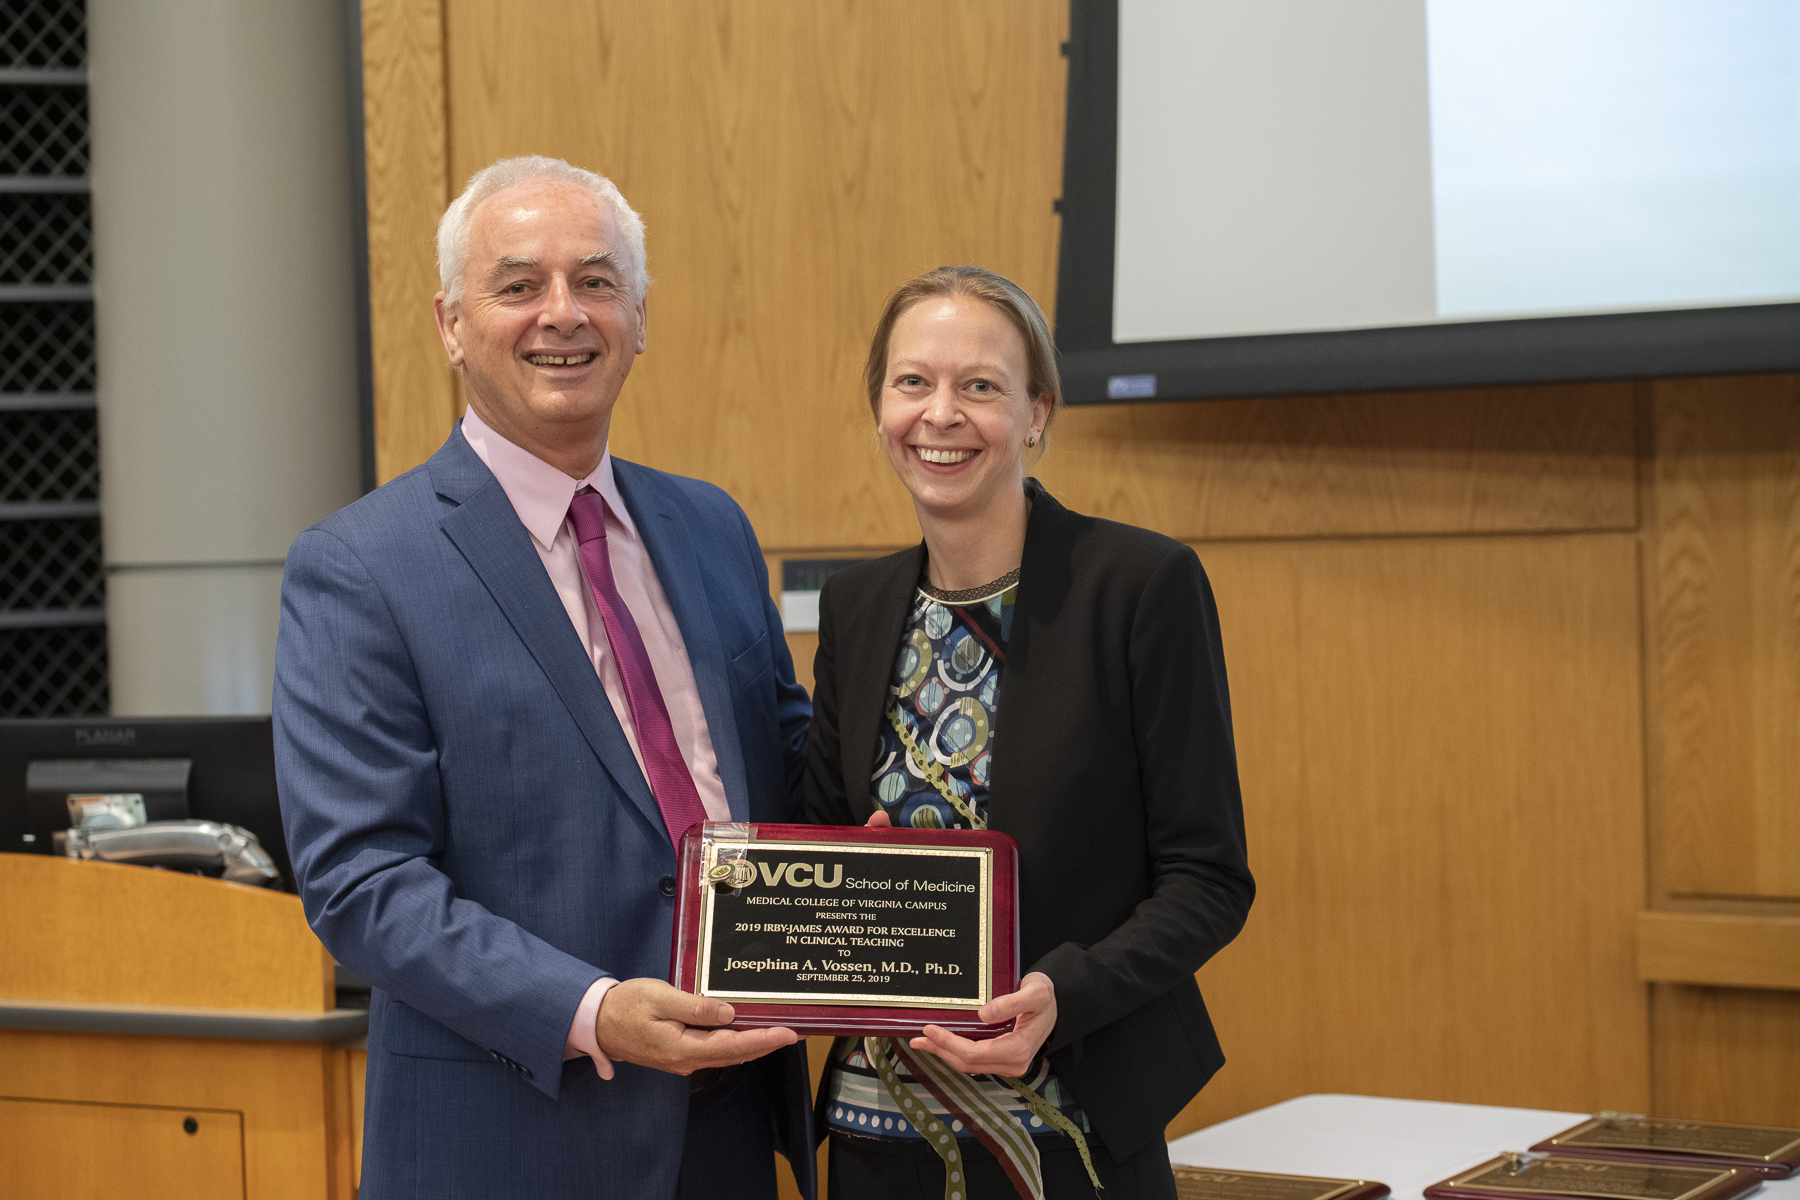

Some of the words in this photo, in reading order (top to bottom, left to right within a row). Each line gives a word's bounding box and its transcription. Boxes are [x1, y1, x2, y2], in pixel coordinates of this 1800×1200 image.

[758, 862, 843, 888] VCU
[845, 877, 891, 890] School
[895, 880, 909, 890] of
[913, 880, 975, 892] Medicine
[747, 897, 792, 905] MEDICAL
[795, 898, 839, 906] COLLEGE
[842, 899, 856, 907] OF
[858, 900, 902, 909] VIRGINIA
[905, 901, 947, 910] CAMPUS
[816, 912, 857, 920] PRESENTS
[735, 923, 761, 932] 2019
[764, 924, 822, 934] IRBY-JAMES
[824, 925, 864, 934] AWARD
[867, 927, 888, 935] FOR
[891, 927, 956, 937] EXCELLENCE
[786, 936, 797, 944] IN
[800, 936, 848, 945] CLINICAL
[850, 938, 904, 947] TEACHING
[724, 958, 798, 972] Josephina
[802, 960, 817, 970] A.
[822, 960, 876, 973] Vossen,
[881, 962, 919, 975] M.D.,
[925, 963, 962, 975] Ph.D.
[796, 973, 849, 981] SEPTEMBER
[868, 975, 890, 983] 2019
